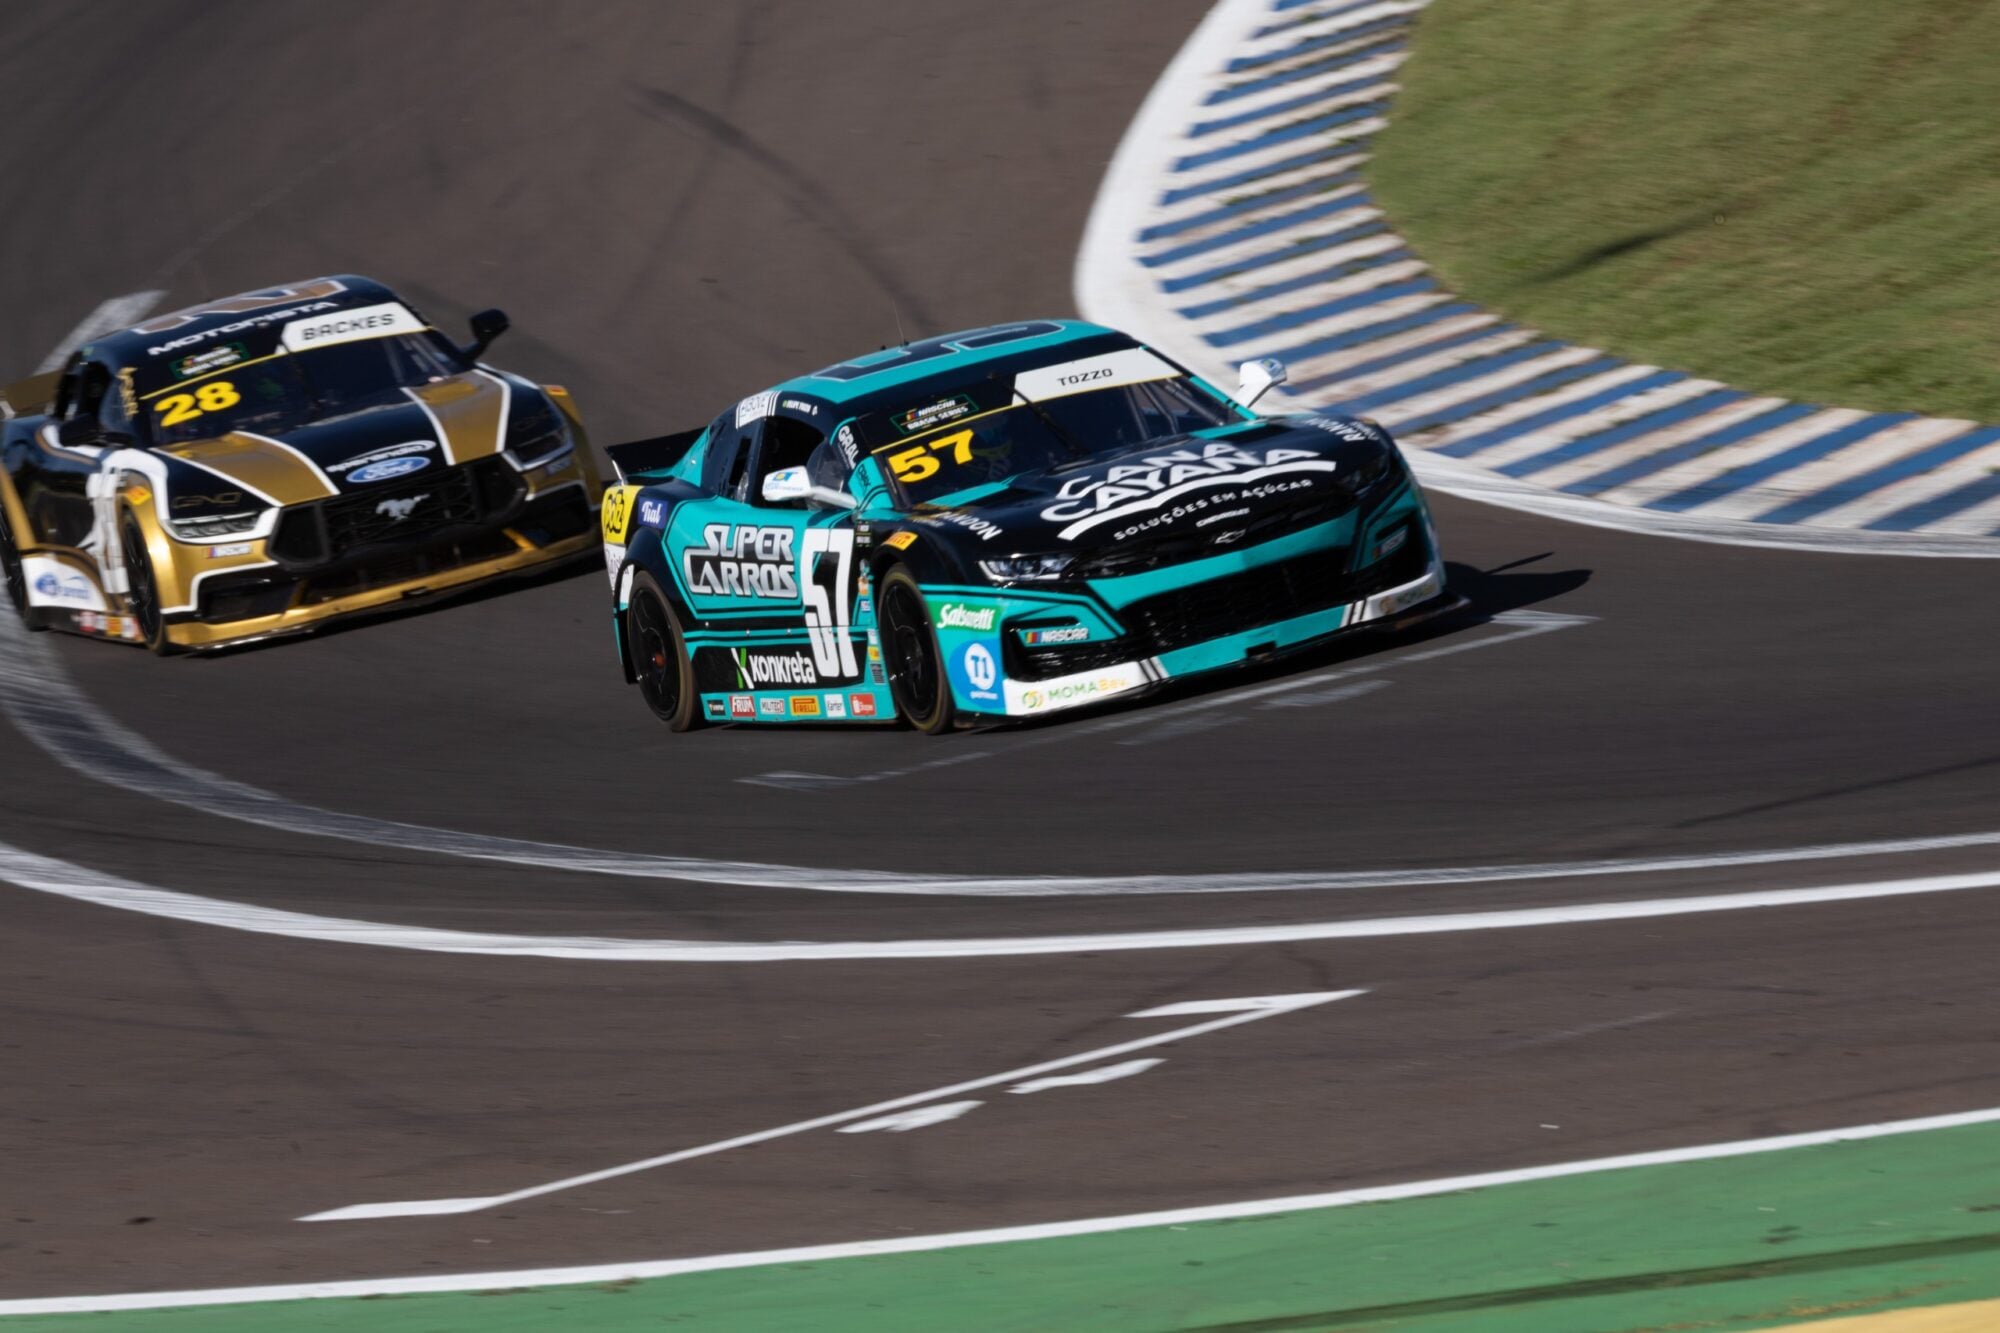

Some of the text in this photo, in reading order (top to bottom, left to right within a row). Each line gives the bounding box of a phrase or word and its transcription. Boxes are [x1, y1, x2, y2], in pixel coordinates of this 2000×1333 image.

[147, 301, 338, 355] MOTORISTA
[303, 313, 395, 341] BACKES
[1057, 368, 1114, 386] TOZZO
[154, 381, 240, 427] 28
[907, 416, 938, 430] BRASIL
[918, 400, 956, 416] NASCAR
[838, 425, 859, 470] GRAL
[888, 429, 974, 482] 57
[1040, 449, 1320, 521] CAYANA
[1056, 443, 1242, 500] CANA
[1113, 479, 1313, 541] SOLUÇÕES EM AÇÚCAR
[703, 523, 795, 562] SUPER
[683, 548, 798, 598] CARROS
[800, 528, 859, 678] 57
[1041, 627, 1088, 643] NASCAR
